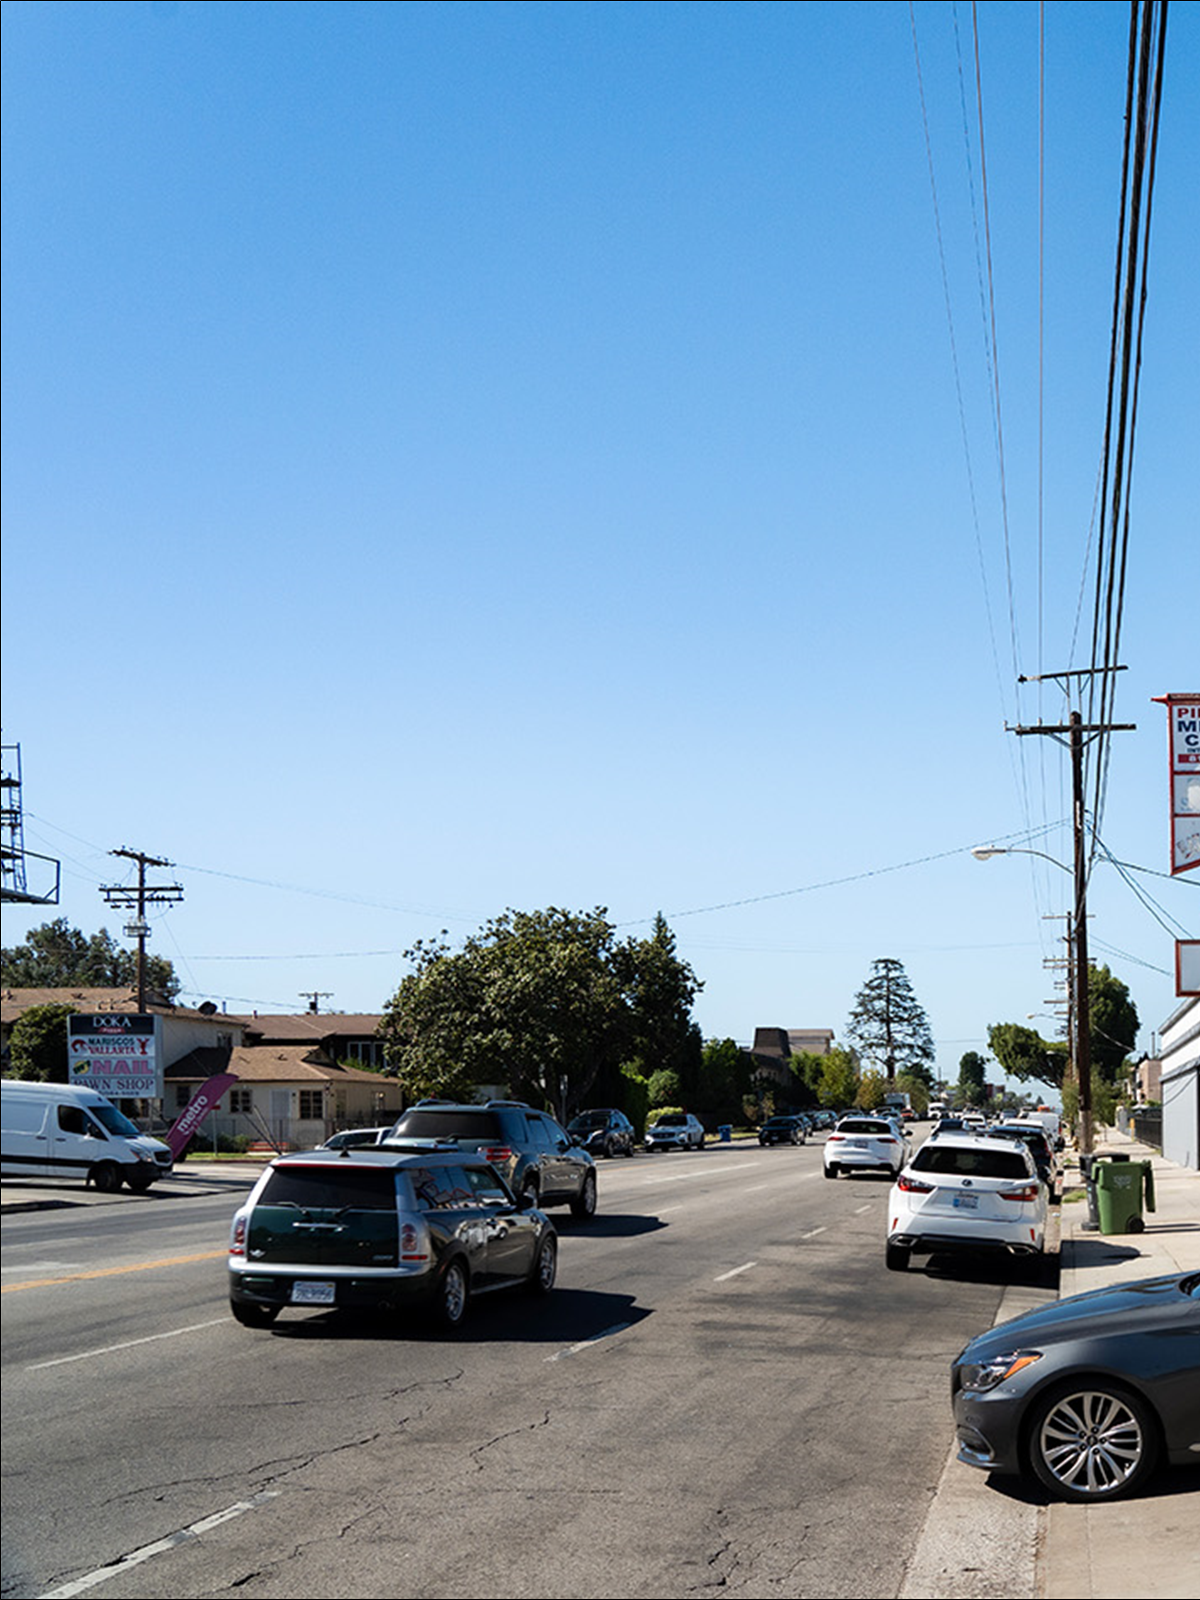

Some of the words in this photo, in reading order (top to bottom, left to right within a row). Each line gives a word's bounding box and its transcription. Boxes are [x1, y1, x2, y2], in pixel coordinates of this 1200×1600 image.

[93, 1016, 132, 1027] DOKA
[88, 1037, 135, 1046] MARISCOS
[92, 1060, 153, 1075] NAIL
[117, 1079, 154, 1090] SHOP
[176, 1095, 208, 1132] metro
